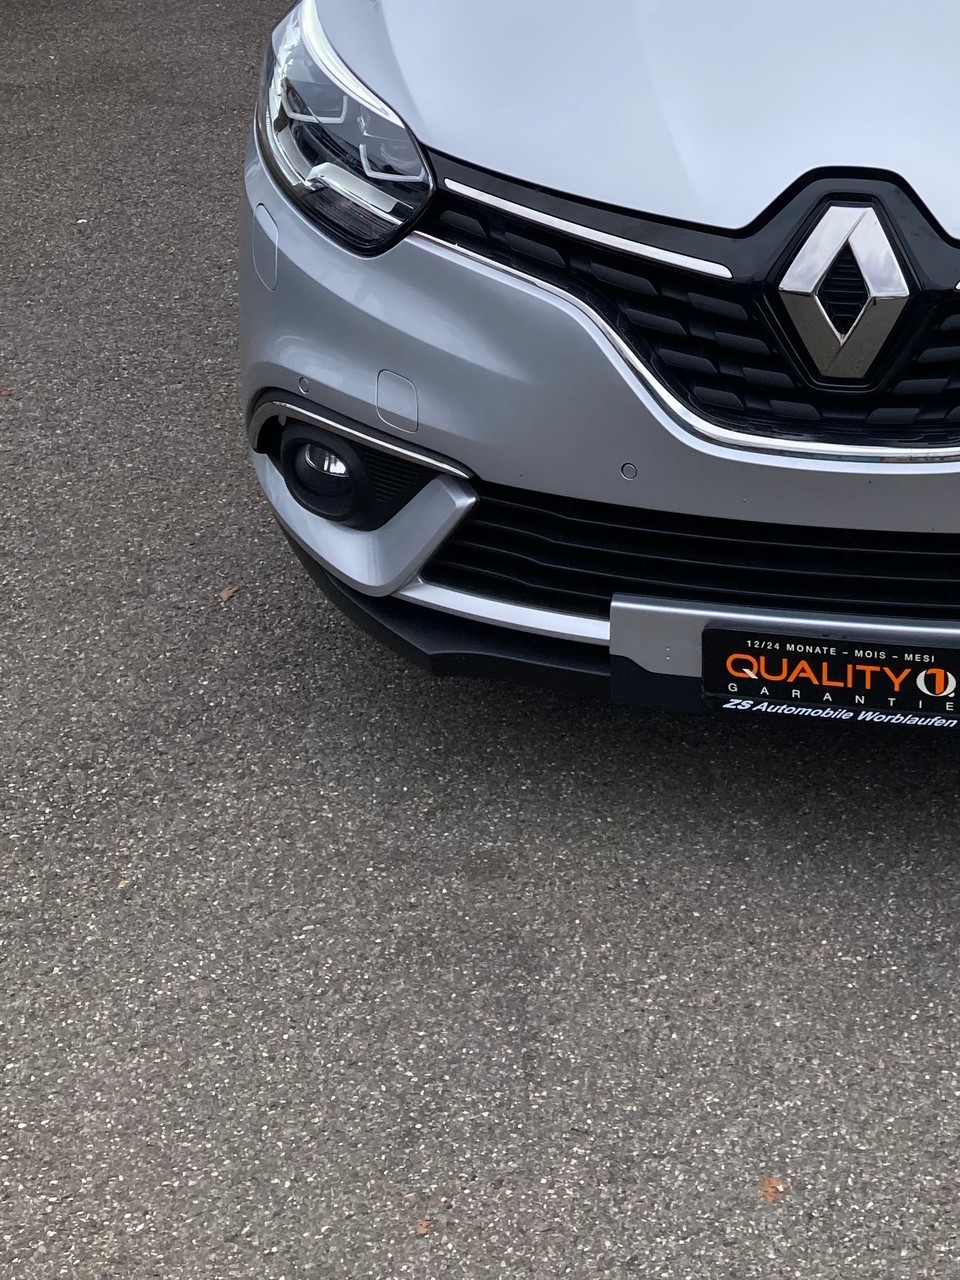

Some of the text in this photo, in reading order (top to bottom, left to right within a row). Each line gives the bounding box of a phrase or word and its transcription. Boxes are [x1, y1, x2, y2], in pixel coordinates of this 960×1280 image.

[746, 639, 781, 651] 12/24
[786, 643, 837, 657] MONATE
[854, 649, 887, 660] MOIS
[904, 653, 936, 664] MESI
[725, 652, 912, 692] QUALITY
[727, 682, 955, 712] GARANTIE
[722, 698, 958, 728] ZS Automobile Worblaufen
